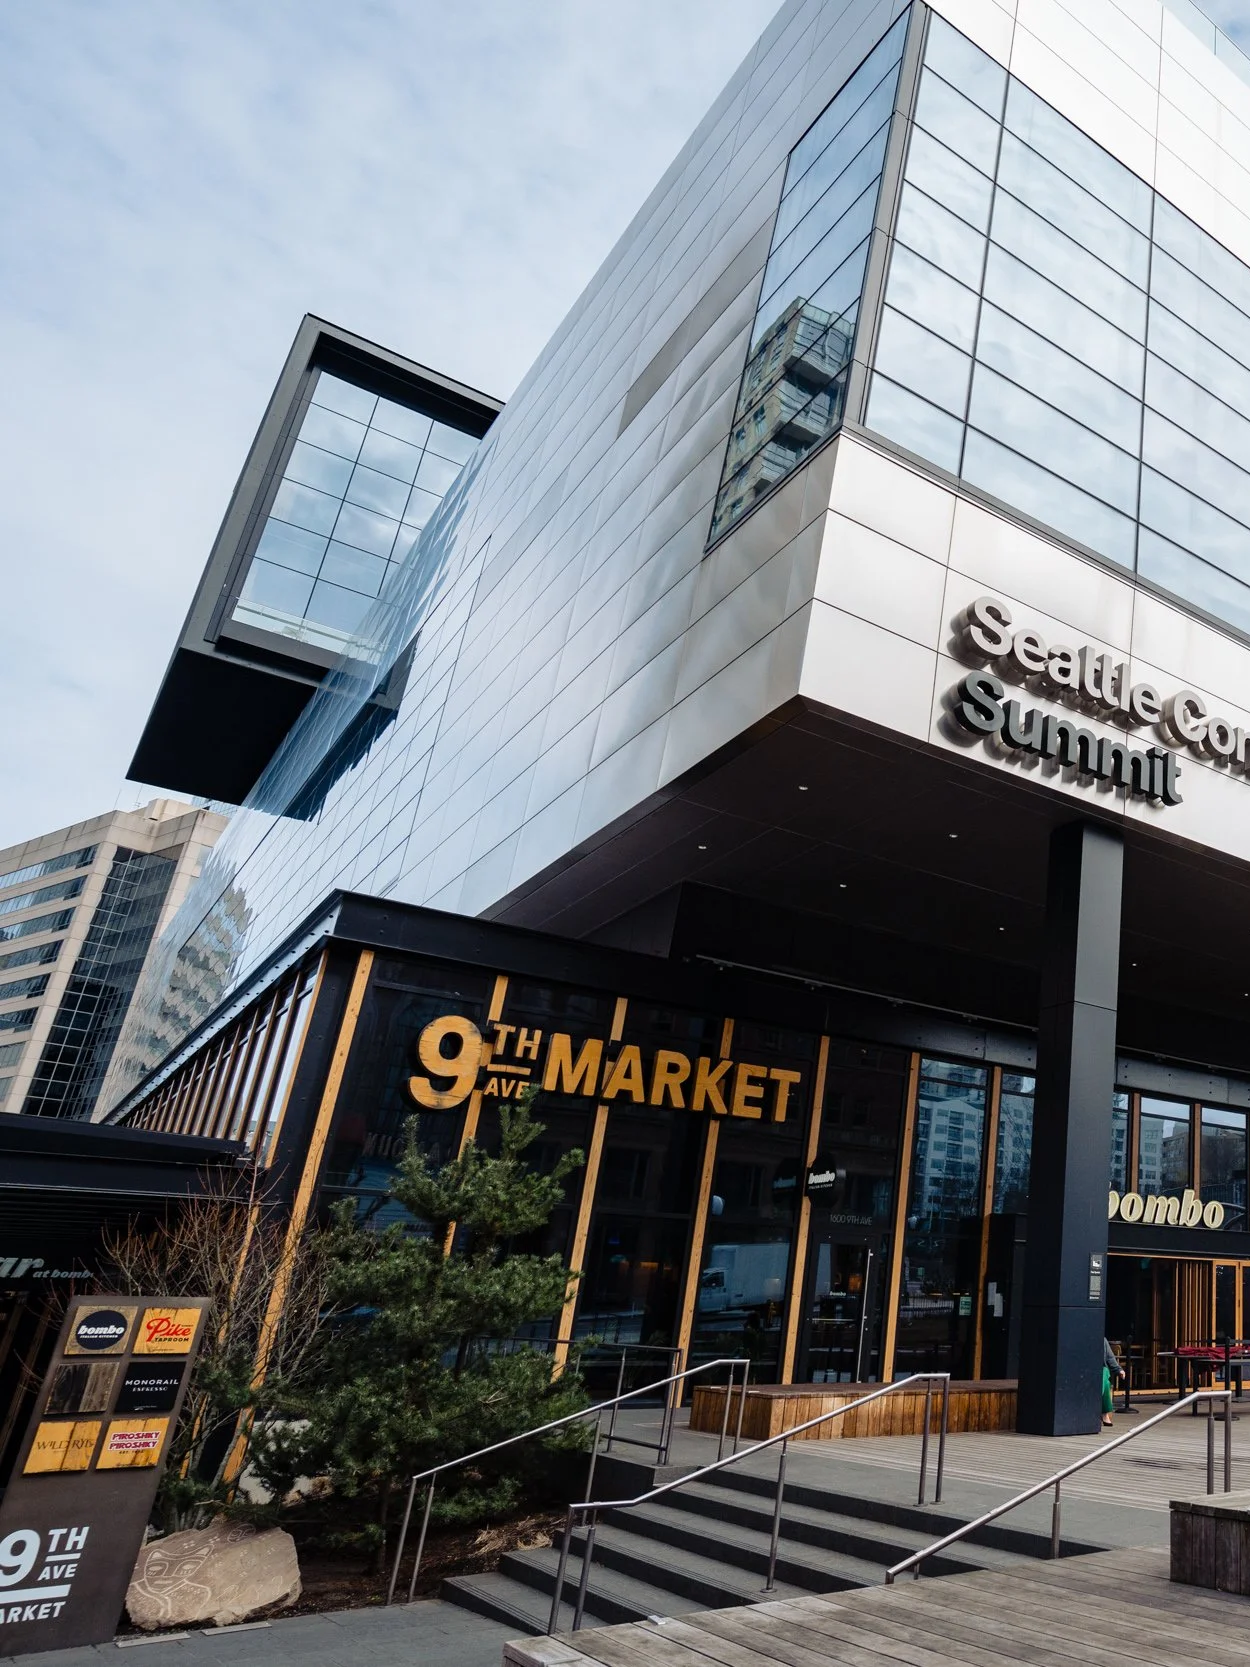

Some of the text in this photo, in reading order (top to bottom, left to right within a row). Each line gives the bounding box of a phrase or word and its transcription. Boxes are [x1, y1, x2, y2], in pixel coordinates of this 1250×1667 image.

[966, 596, 1162, 728] Seattle
[956, 671, 1184, 806] Summit
[483, 1076, 531, 1100] AVE
[543, 1032, 801, 1123] MARKET
[830, 1214, 846, 1224] 1600
[860, 1216, 873, 1226] AVE
[50, 1268, 94, 1279] bomb
[77, 1325, 125, 1335] bombo
[145, 1316, 192, 1343] Pike
[125, 1378, 180, 1386] MONORAIL
[111, 1431, 161, 1441] PIROSHKY
[36, 1439, 70, 1450] WILD
[108, 1441, 158, 1450] PIROSHKY
[37, 1563, 79, 1582] AVE
